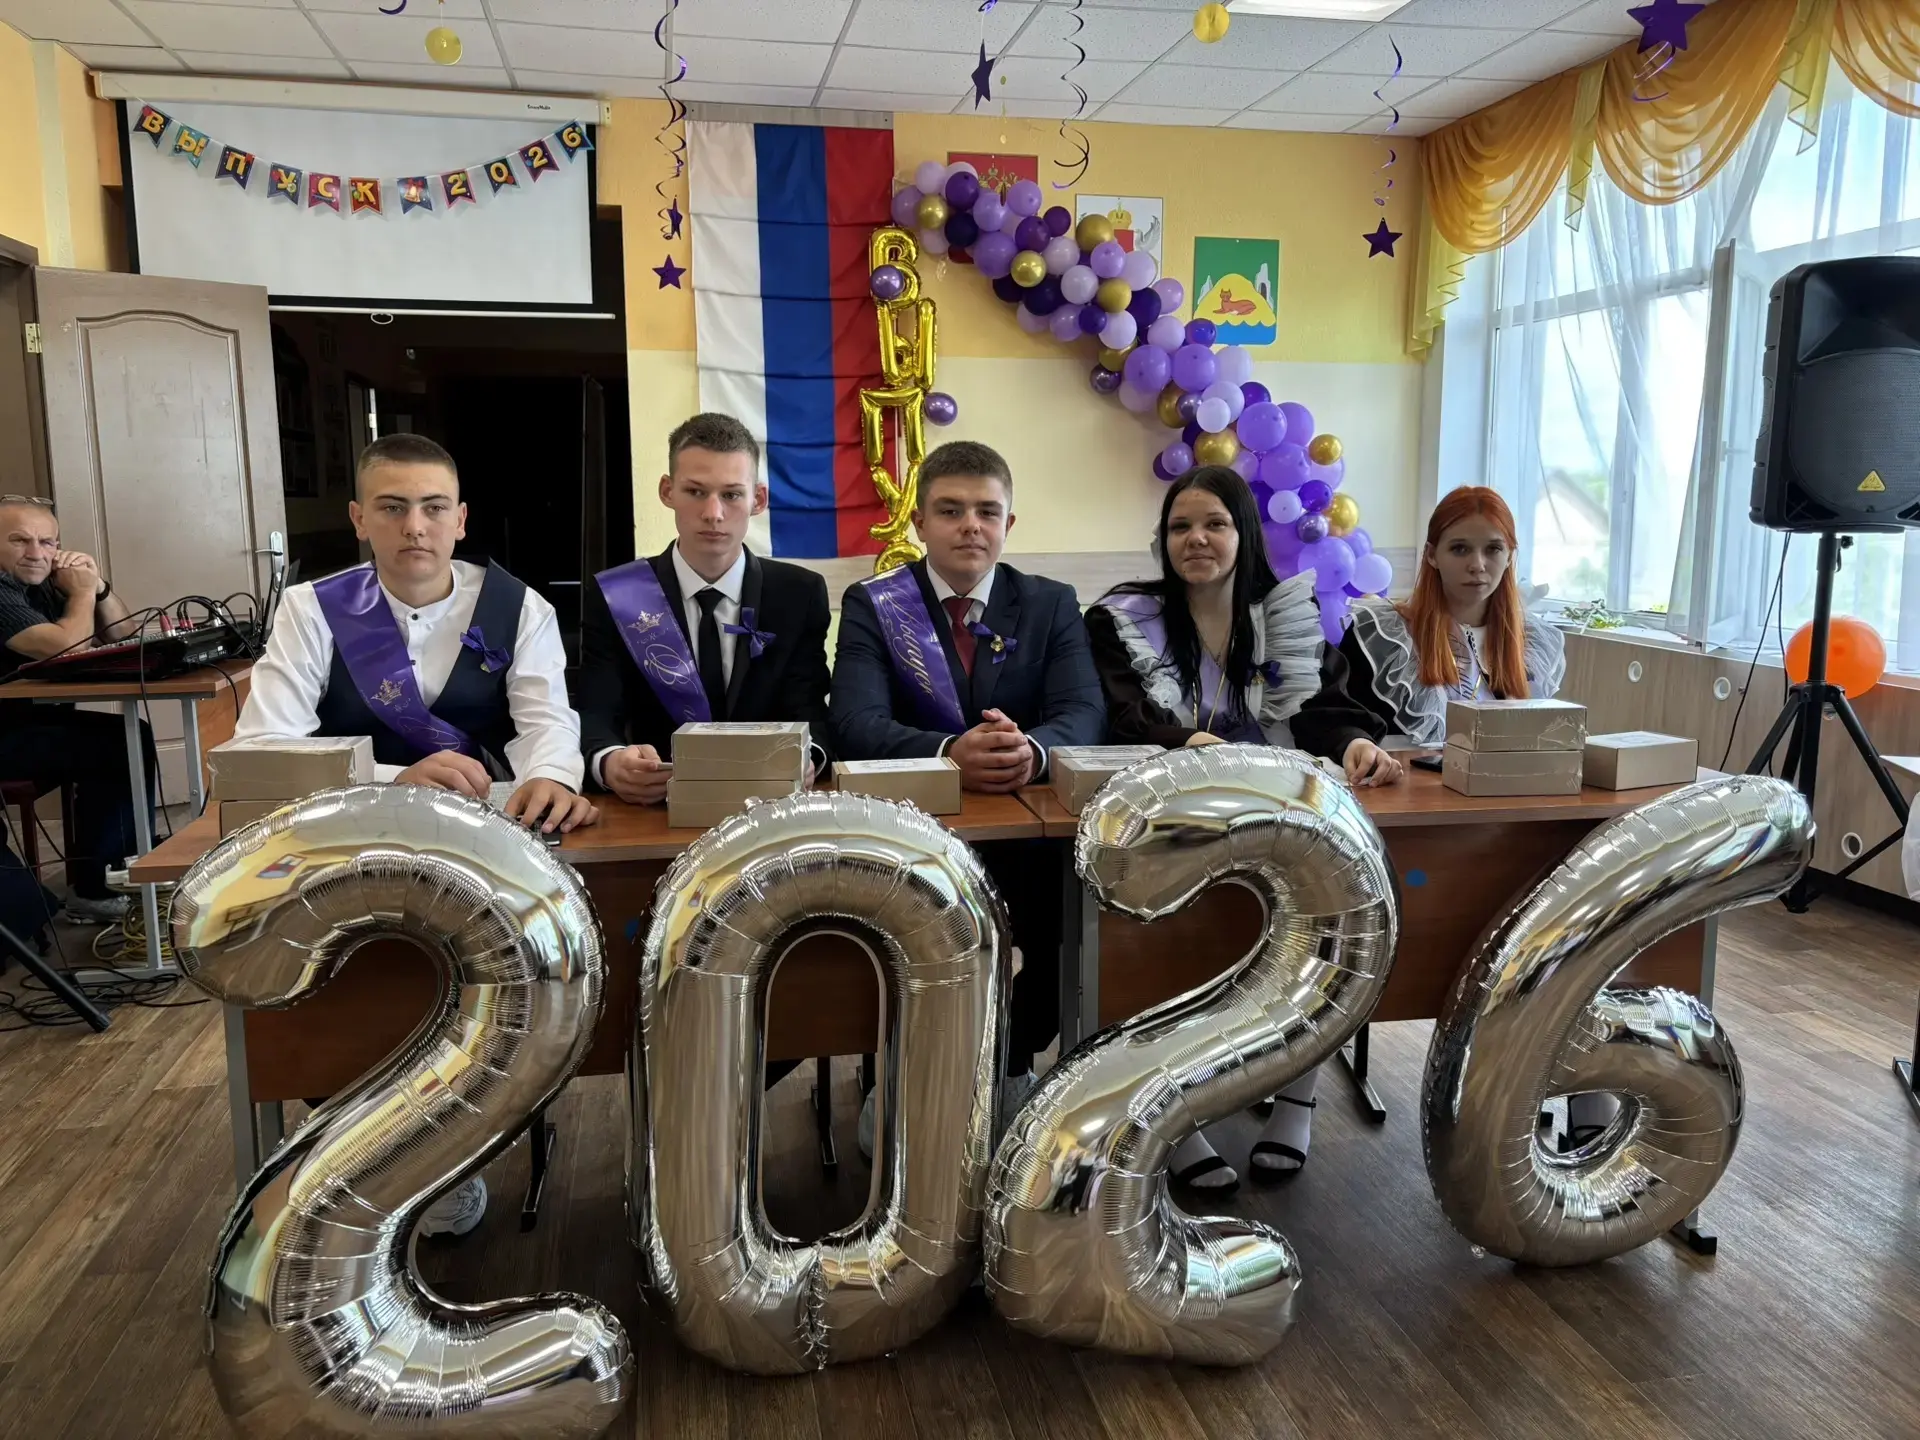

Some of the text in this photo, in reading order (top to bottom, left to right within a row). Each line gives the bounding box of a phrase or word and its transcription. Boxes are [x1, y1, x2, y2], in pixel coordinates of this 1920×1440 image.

[142, 111, 582, 205] ВЫПУСК 2026
[172, 743, 1816, 1440] 2026
